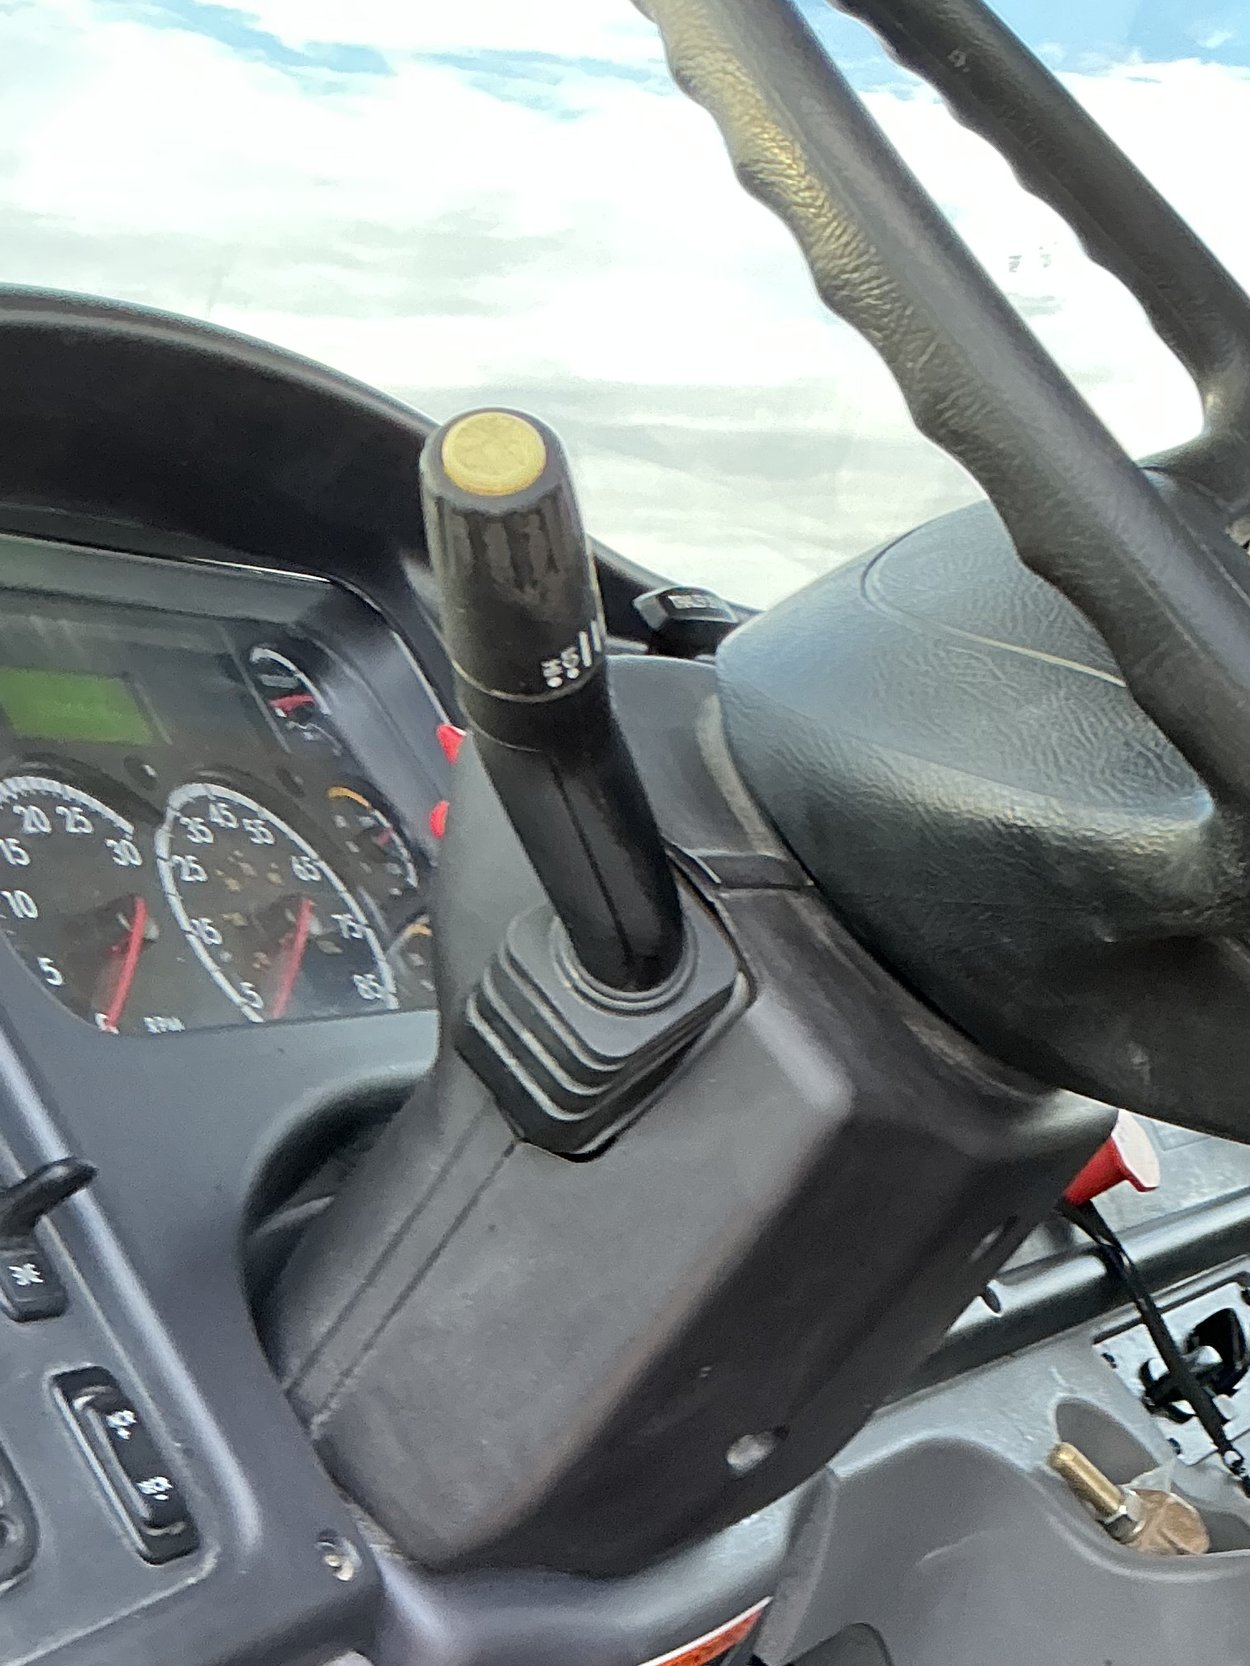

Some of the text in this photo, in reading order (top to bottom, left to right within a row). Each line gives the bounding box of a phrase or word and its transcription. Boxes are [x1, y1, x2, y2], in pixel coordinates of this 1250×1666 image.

[13, 805, 52, 834] 20
[55, 805, 94, 834] 25
[209, 803, 239, 829] 45
[179, 817, 214, 844] 35
[242, 818, 275, 845] 55
[104, 839, 143, 866] 30
[171, 855, 208, 882] 25
[291, 855, 321, 881] 65
[1, 890, 38, 919] 10
[331, 913, 365, 939] 75
[37, 957, 65, 986] 5
[239, 981, 264, 1009] 5
[353, 973, 385, 1000] 85
